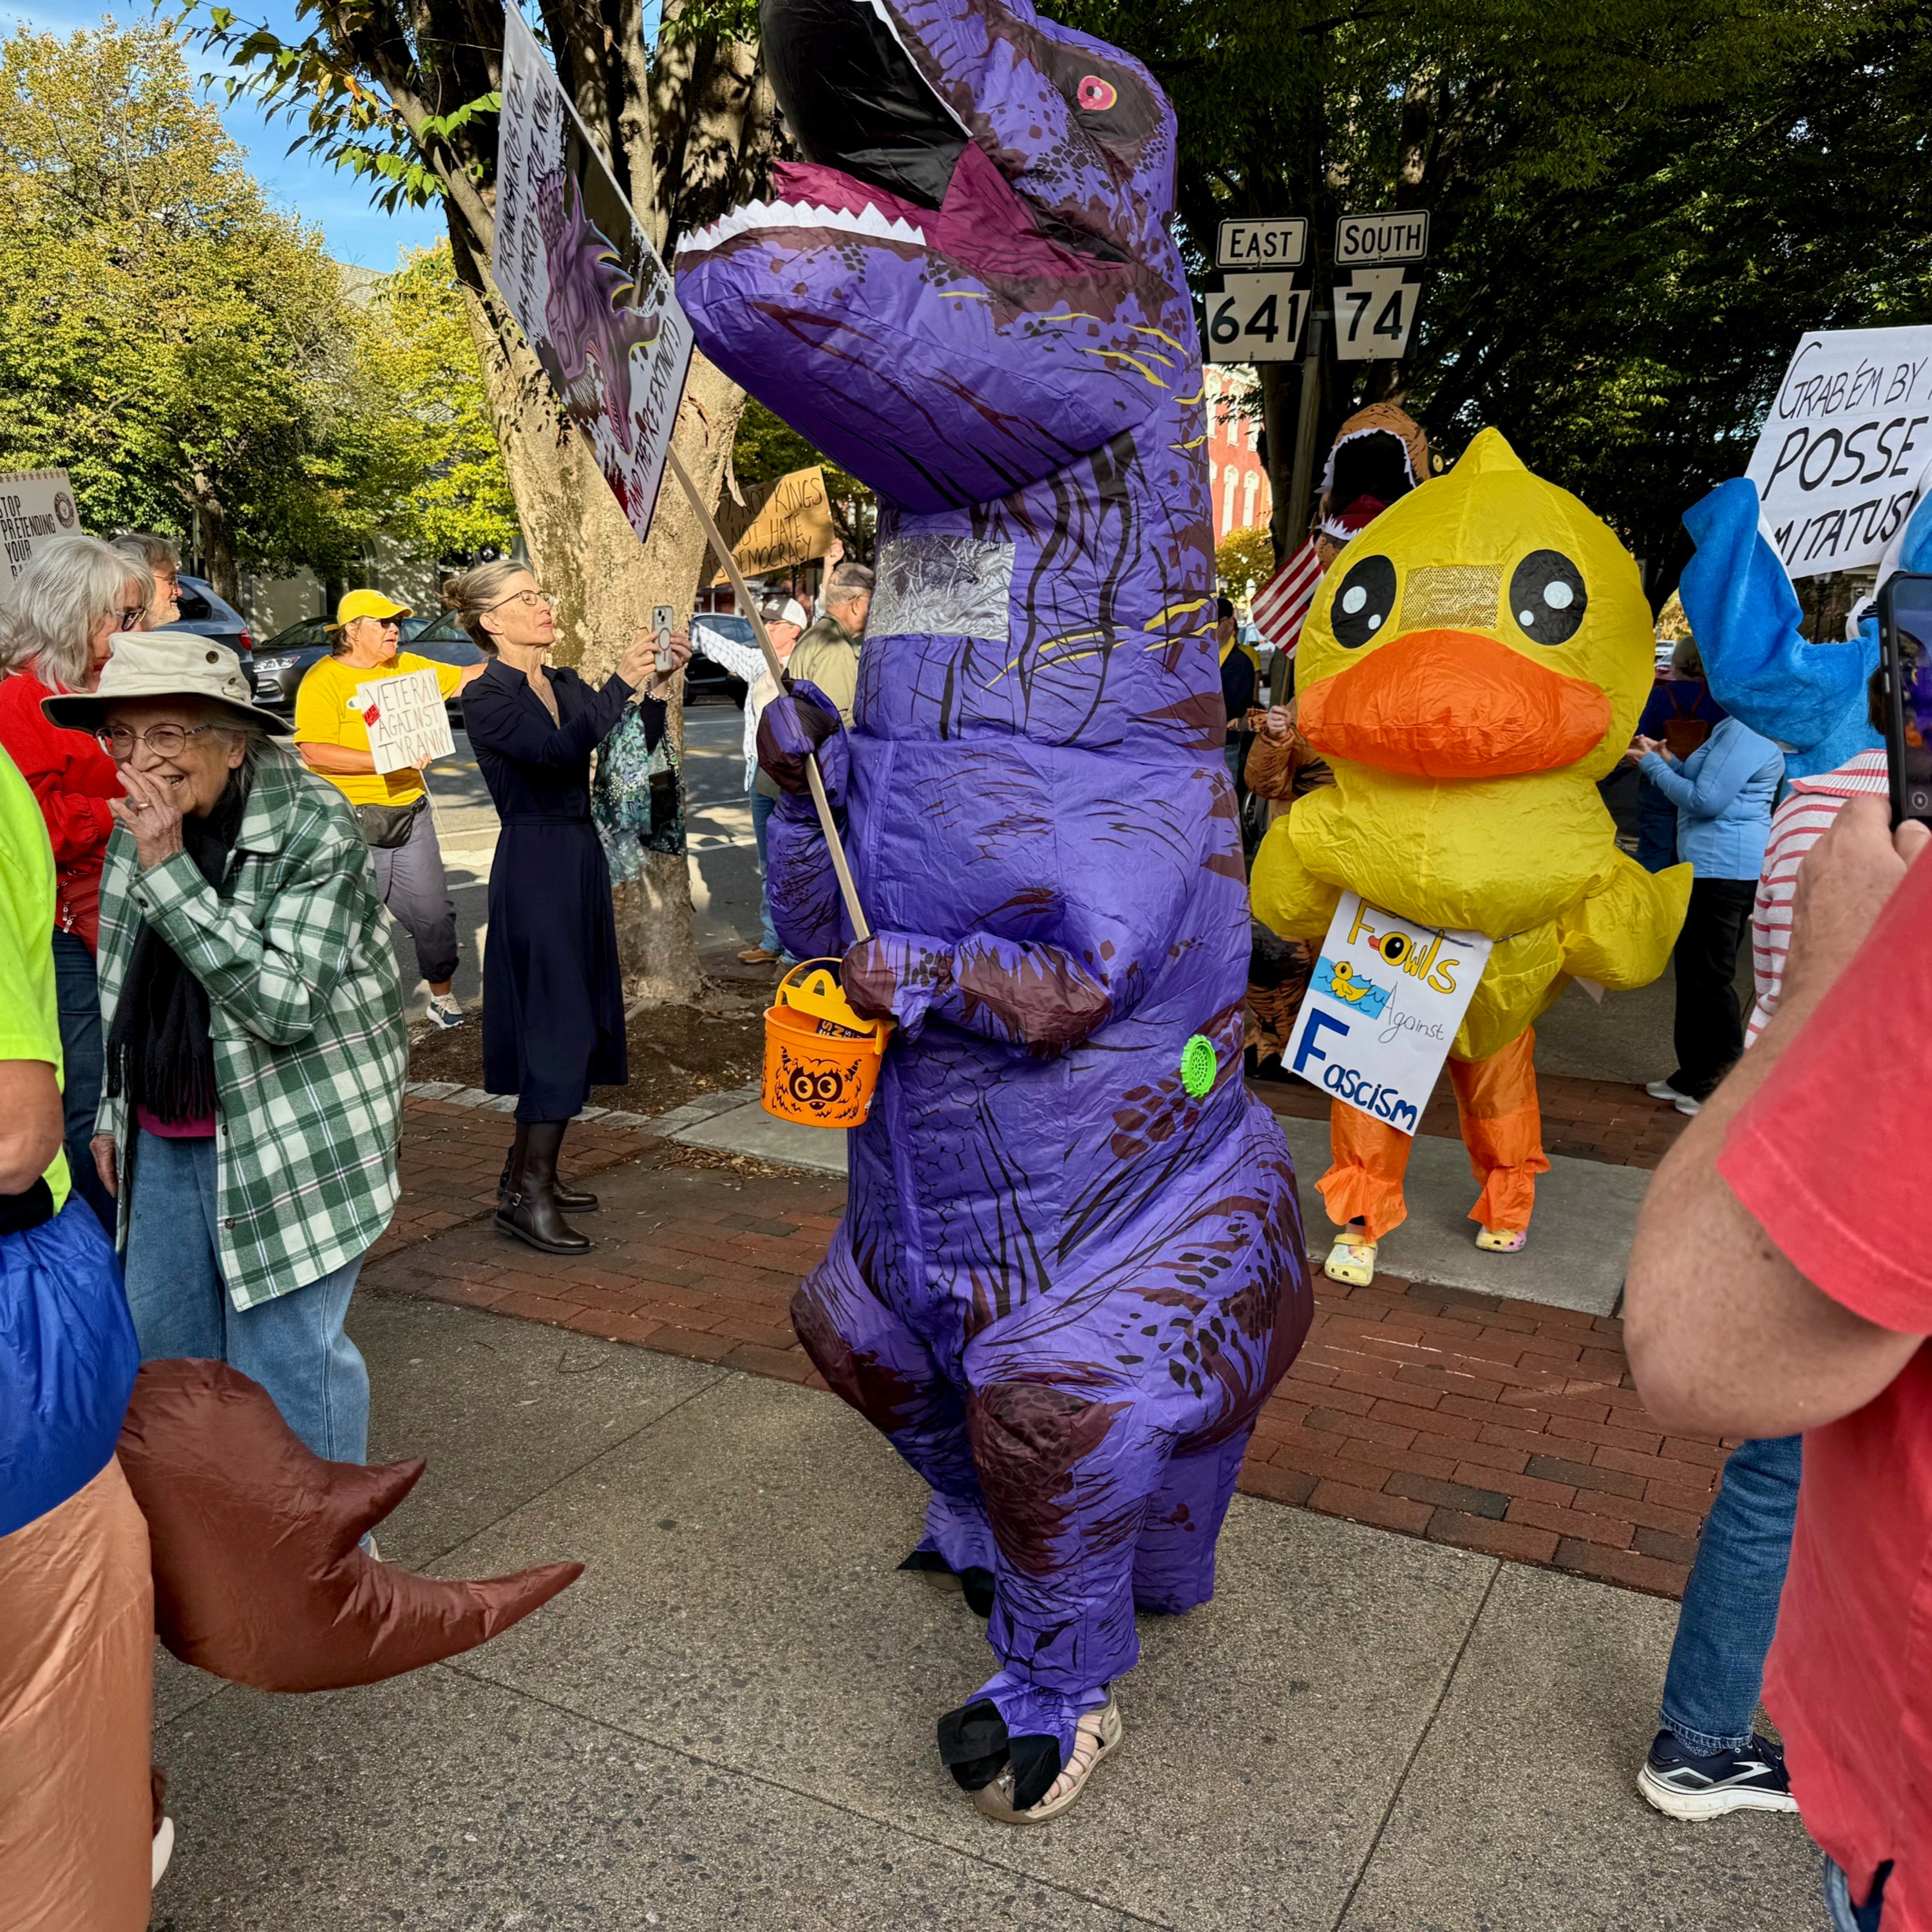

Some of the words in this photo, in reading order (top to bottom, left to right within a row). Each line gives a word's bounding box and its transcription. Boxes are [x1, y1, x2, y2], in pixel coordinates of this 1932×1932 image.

[507, 53, 526, 131] REX
[531, 68, 553, 146] KING!
[526, 128, 544, 197] TRUE
[499, 117, 524, 287] TYRANNOSAURUS
[520, 191, 545, 298] AMERICA'S
[1230, 229, 1293, 258] EAST
[1344, 223, 1421, 255] SOUTH
[517, 287, 536, 336] WAS
[1211, 294, 1300, 345] 641
[1346, 290, 1403, 341] 74
[1884, 357, 1928, 405] BY
[1761, 416, 1929, 501] POSSE
[775, 477, 823, 513] KINGS
[1, 513, 57, 540] PRETENDING
[5, 539, 32, 564] YOUR
[732, 521, 759, 547] NOT
[770, 513, 803, 547] HATE
[1774, 491, 1913, 566] MITATUS
[366, 674, 440, 713] VETERAN
[379, 703, 440, 741] AGAINST
[378, 726, 450, 770] TYRANNY
[1378, 981, 1444, 1043] Against
[1293, 1007, 1417, 1131] Fascism
